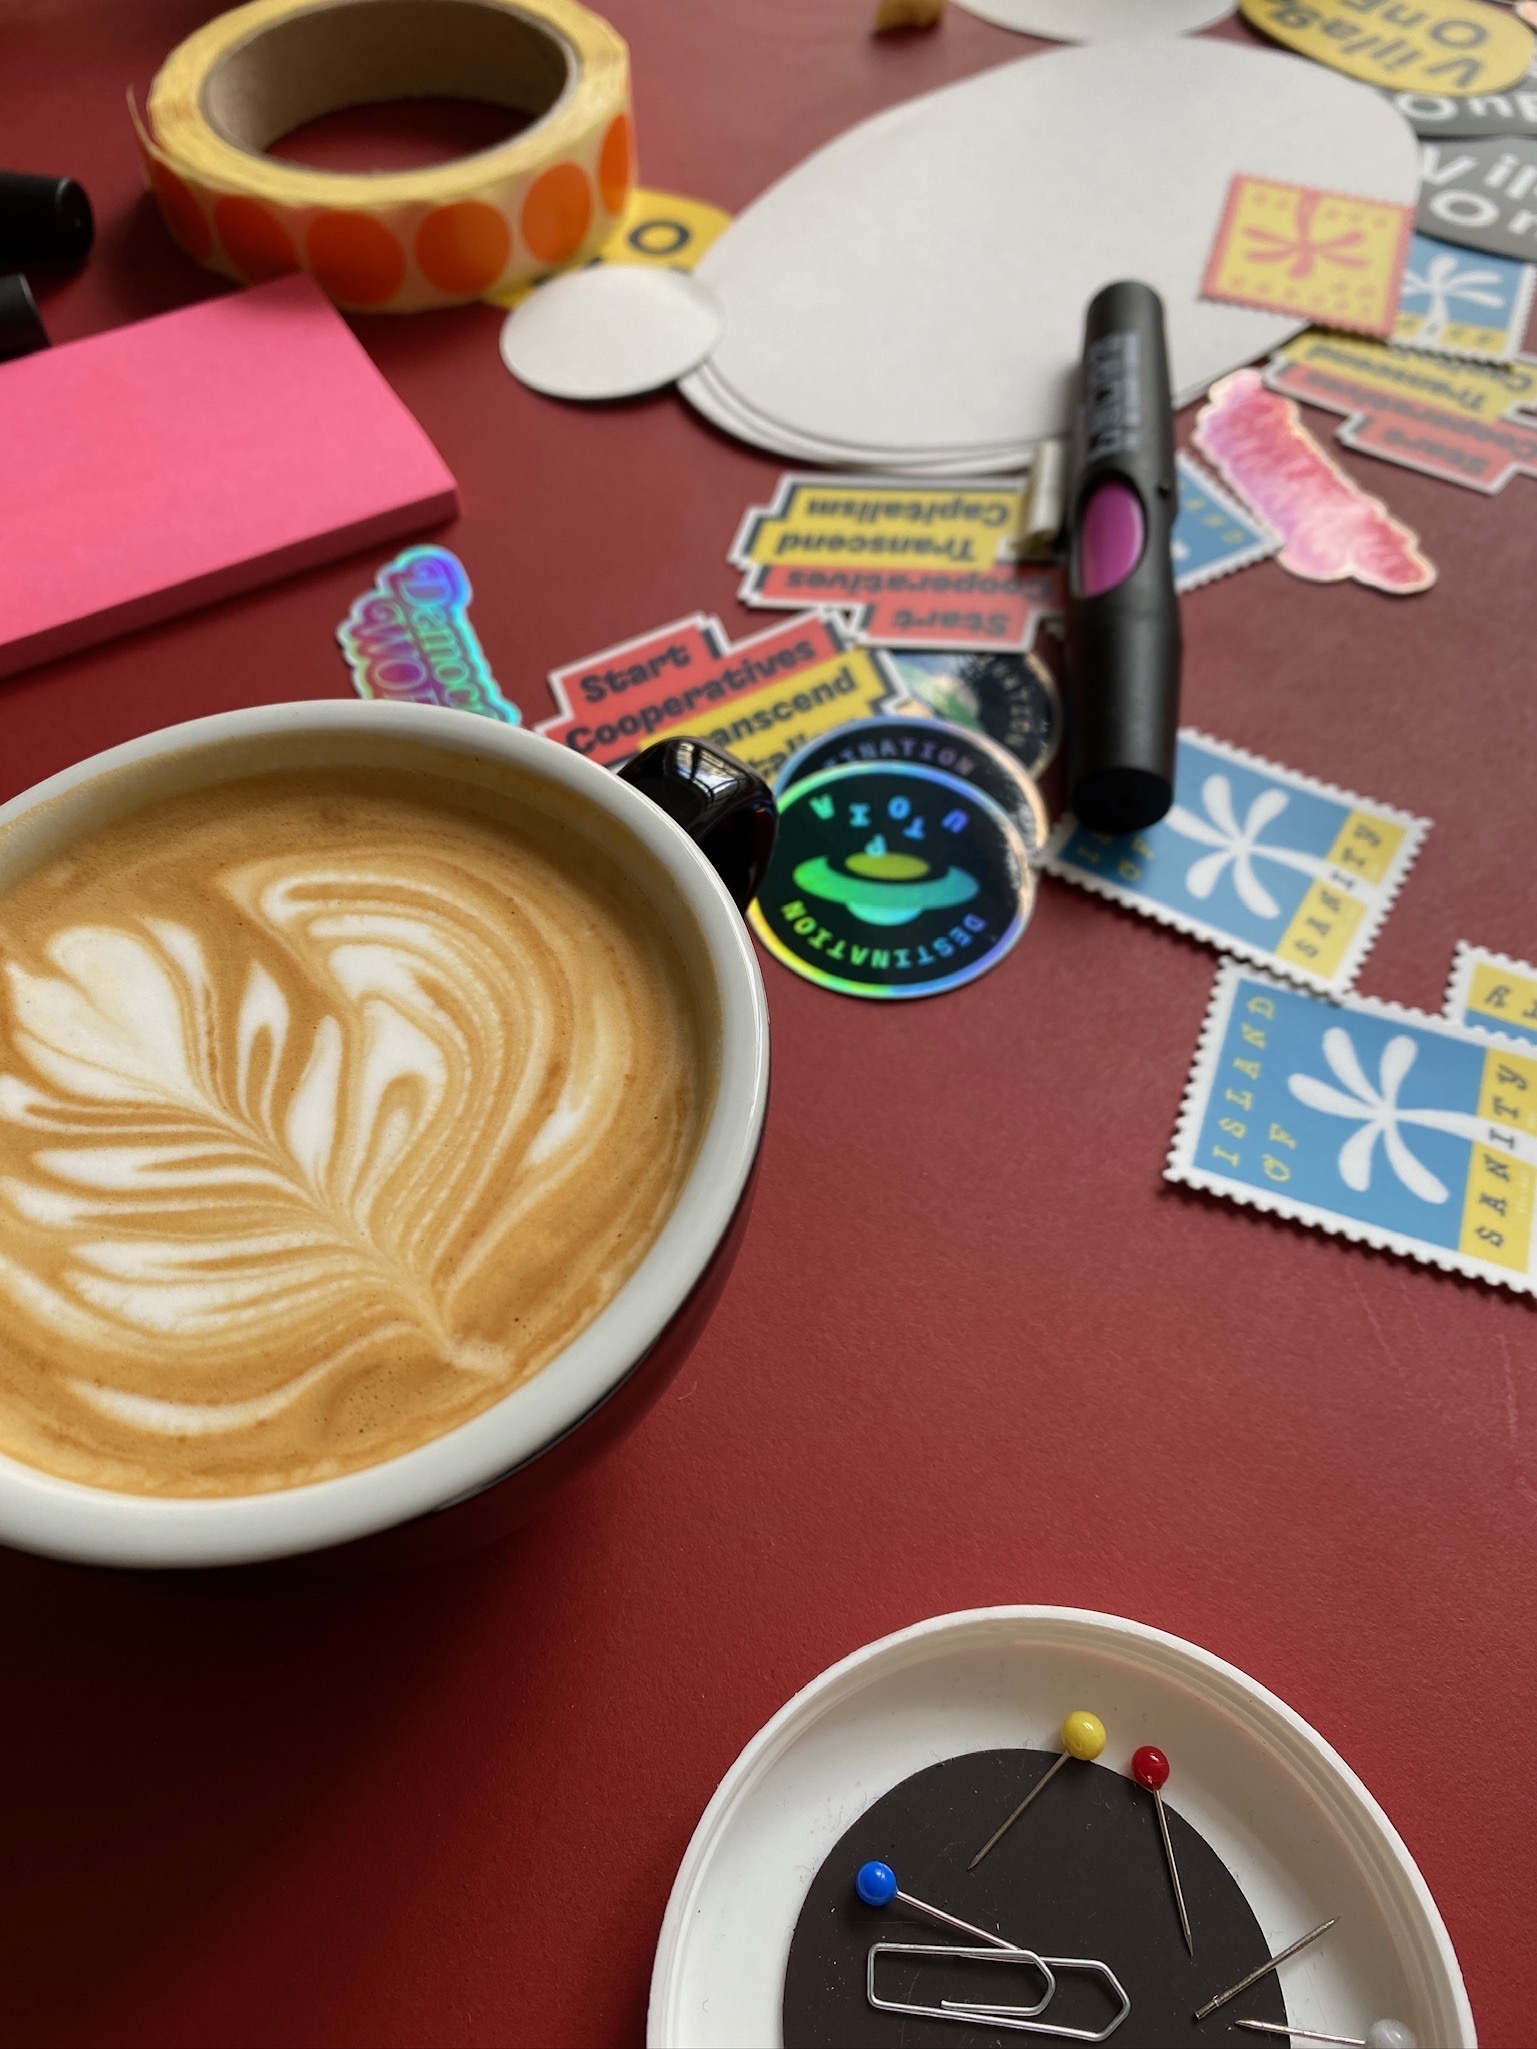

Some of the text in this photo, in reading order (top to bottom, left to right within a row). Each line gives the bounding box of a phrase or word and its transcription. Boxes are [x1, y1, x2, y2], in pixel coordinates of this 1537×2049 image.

[1268, 0, 1483, 88] Villag
[777, 531, 977, 562] Transcend
[806, 496, 1009, 527] Capitalism
[786, 569, 1052, 601] Cooperatives
[892, 608, 1011, 636] Start
[565, 637, 819, 755] Cooperatives
[579, 644, 693, 703] Start
[709, 666, 859, 748] anscend
[1293, 821, 1383, 959] SANITY
[780, 899, 988, 970] DESTINATION
[1212, 996, 1276, 1169] ISLAND
[1262, 1122, 1297, 1183] OF
[1475, 1063, 1529, 1249] SANITY
